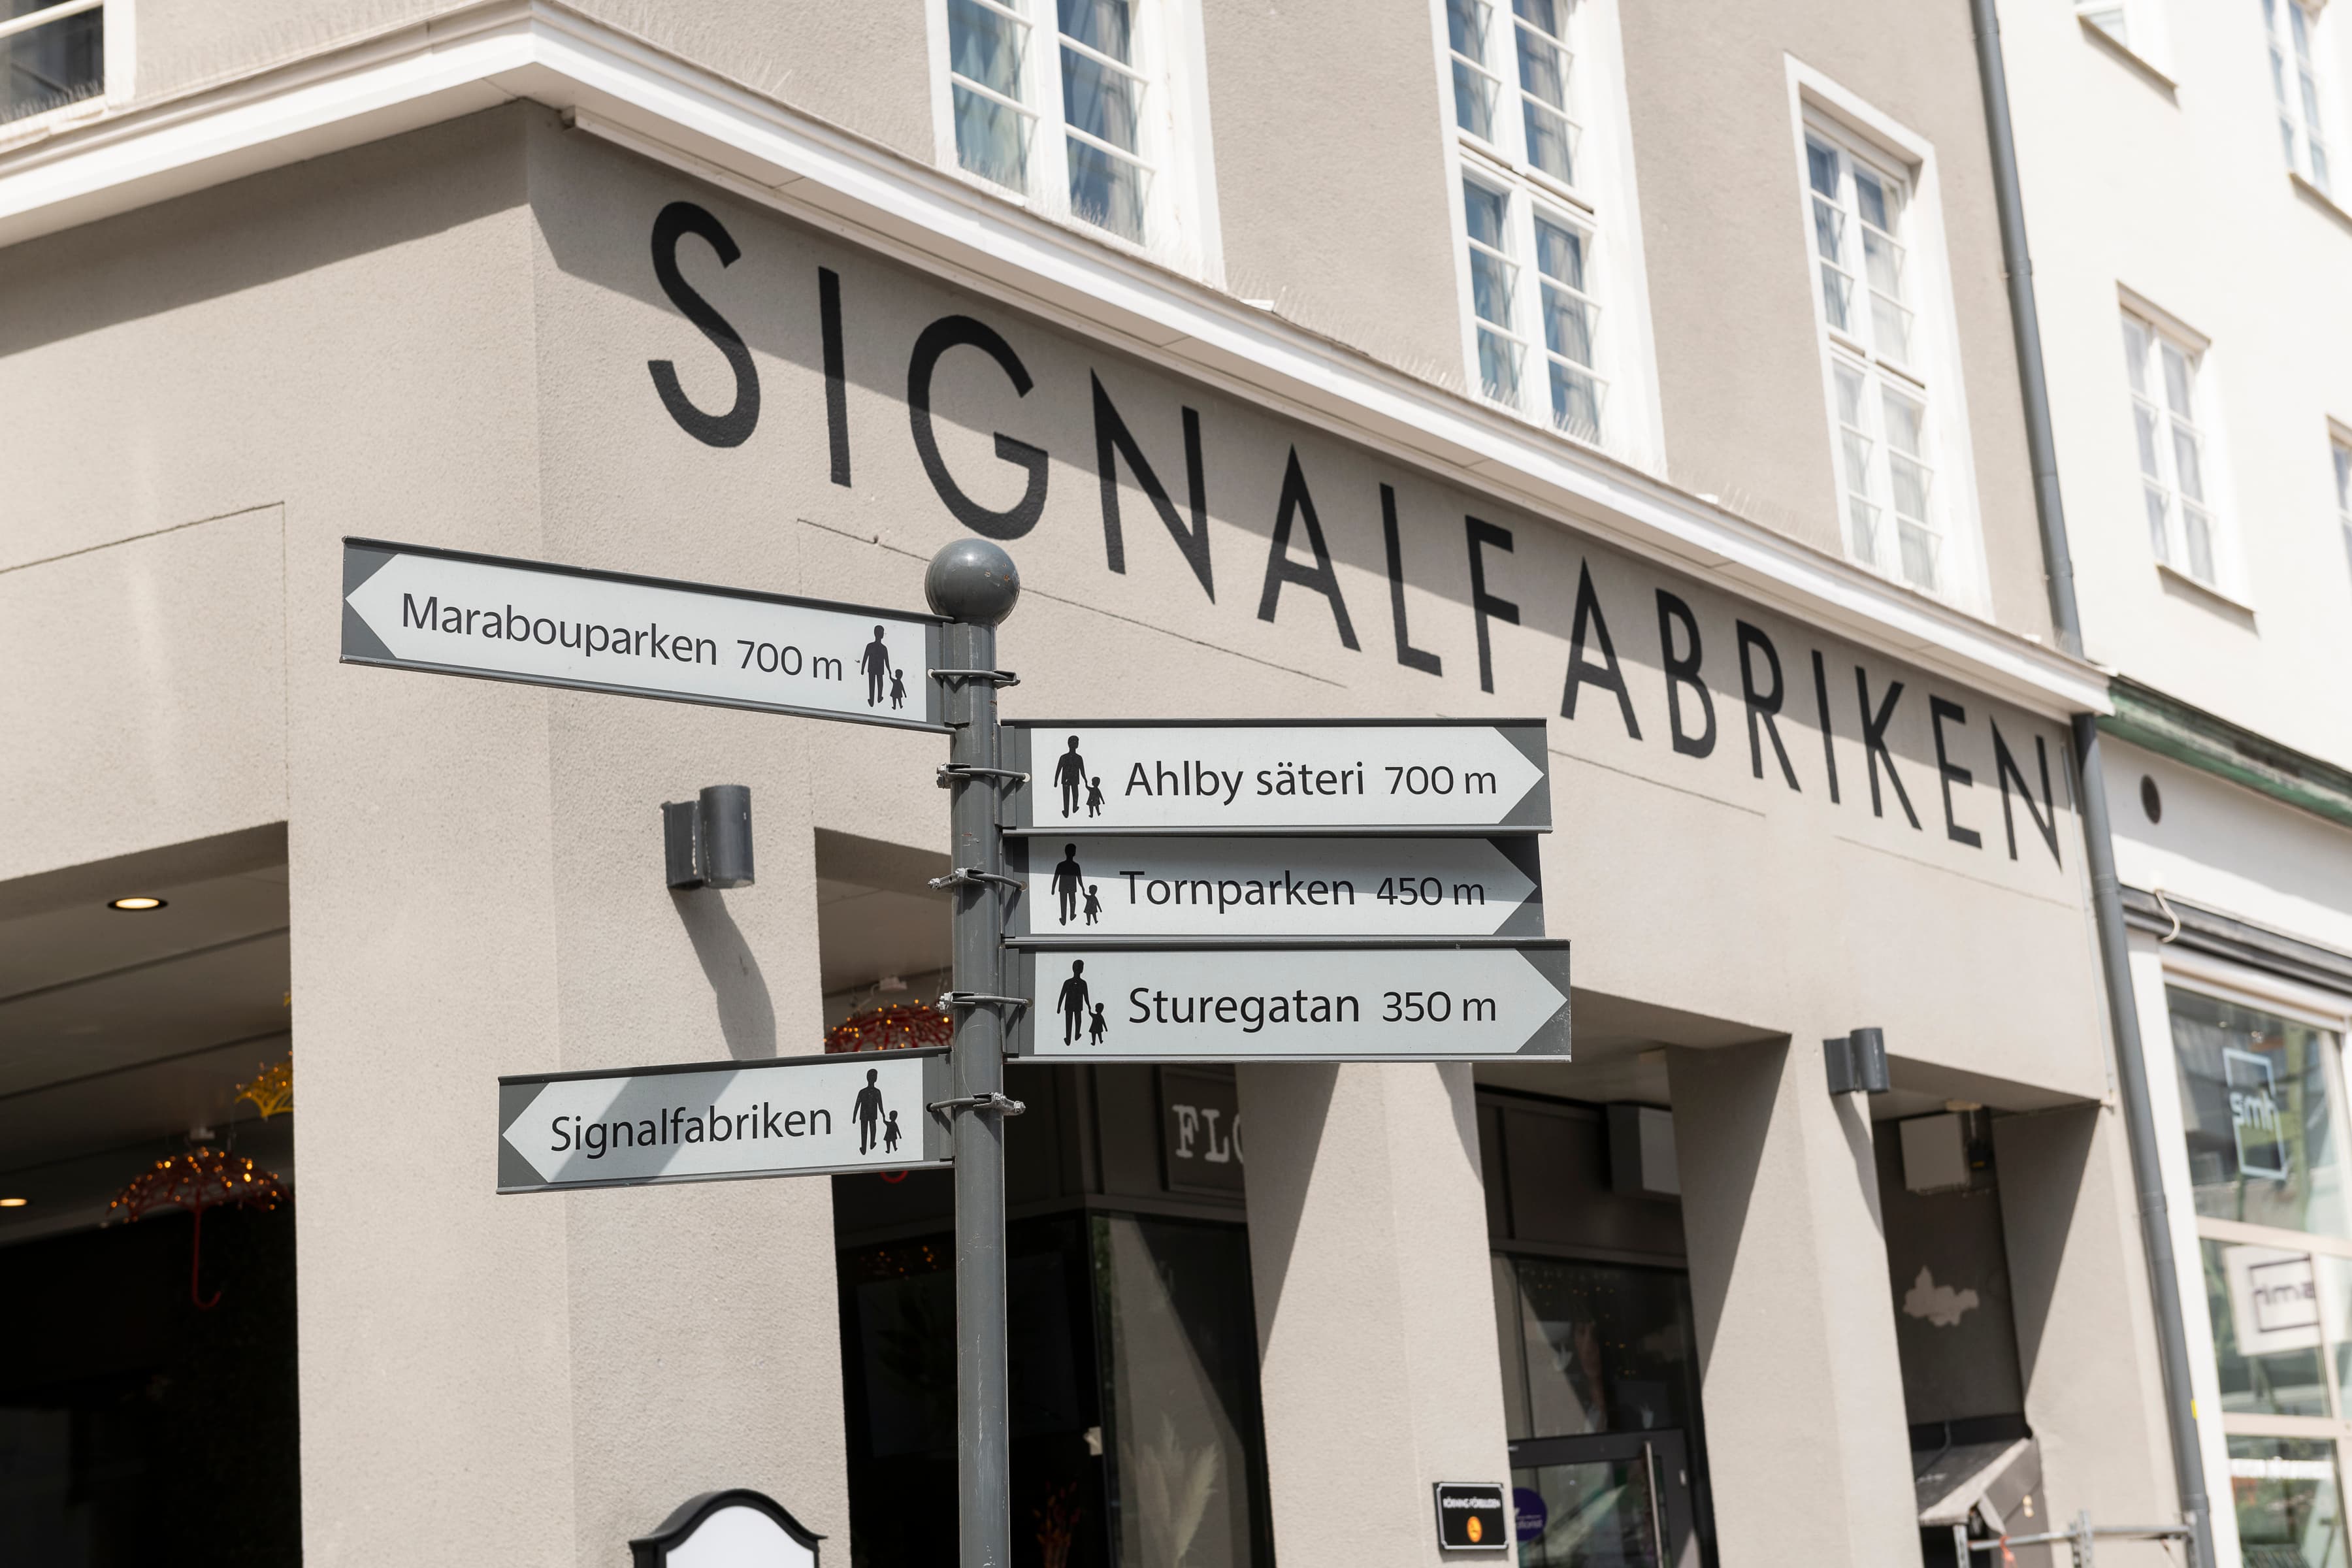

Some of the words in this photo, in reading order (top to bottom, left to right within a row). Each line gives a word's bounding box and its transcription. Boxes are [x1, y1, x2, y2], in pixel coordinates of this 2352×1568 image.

[648, 199, 2065, 873] SIGNALFABRIKEN
[402, 593, 717, 666] Marabouparken
[736, 639, 803, 676] 700
[813, 656, 843, 681] m
[1124, 760, 1244, 807] Ahlby
[1256, 760, 1364, 796] säteri
[1384, 765, 1454, 796] 700
[1464, 772, 1497, 794] m
[1119, 869, 1355, 915] Tornparken
[1376, 876, 1443, 906] 450
[1452, 883, 1485, 906] m
[1128, 987, 1360, 1034] Sturegatan
[1382, 990, 1452, 1022] 350
[1462, 998, 1496, 1022] m
[550, 1101, 832, 1160] Signalfabriken
